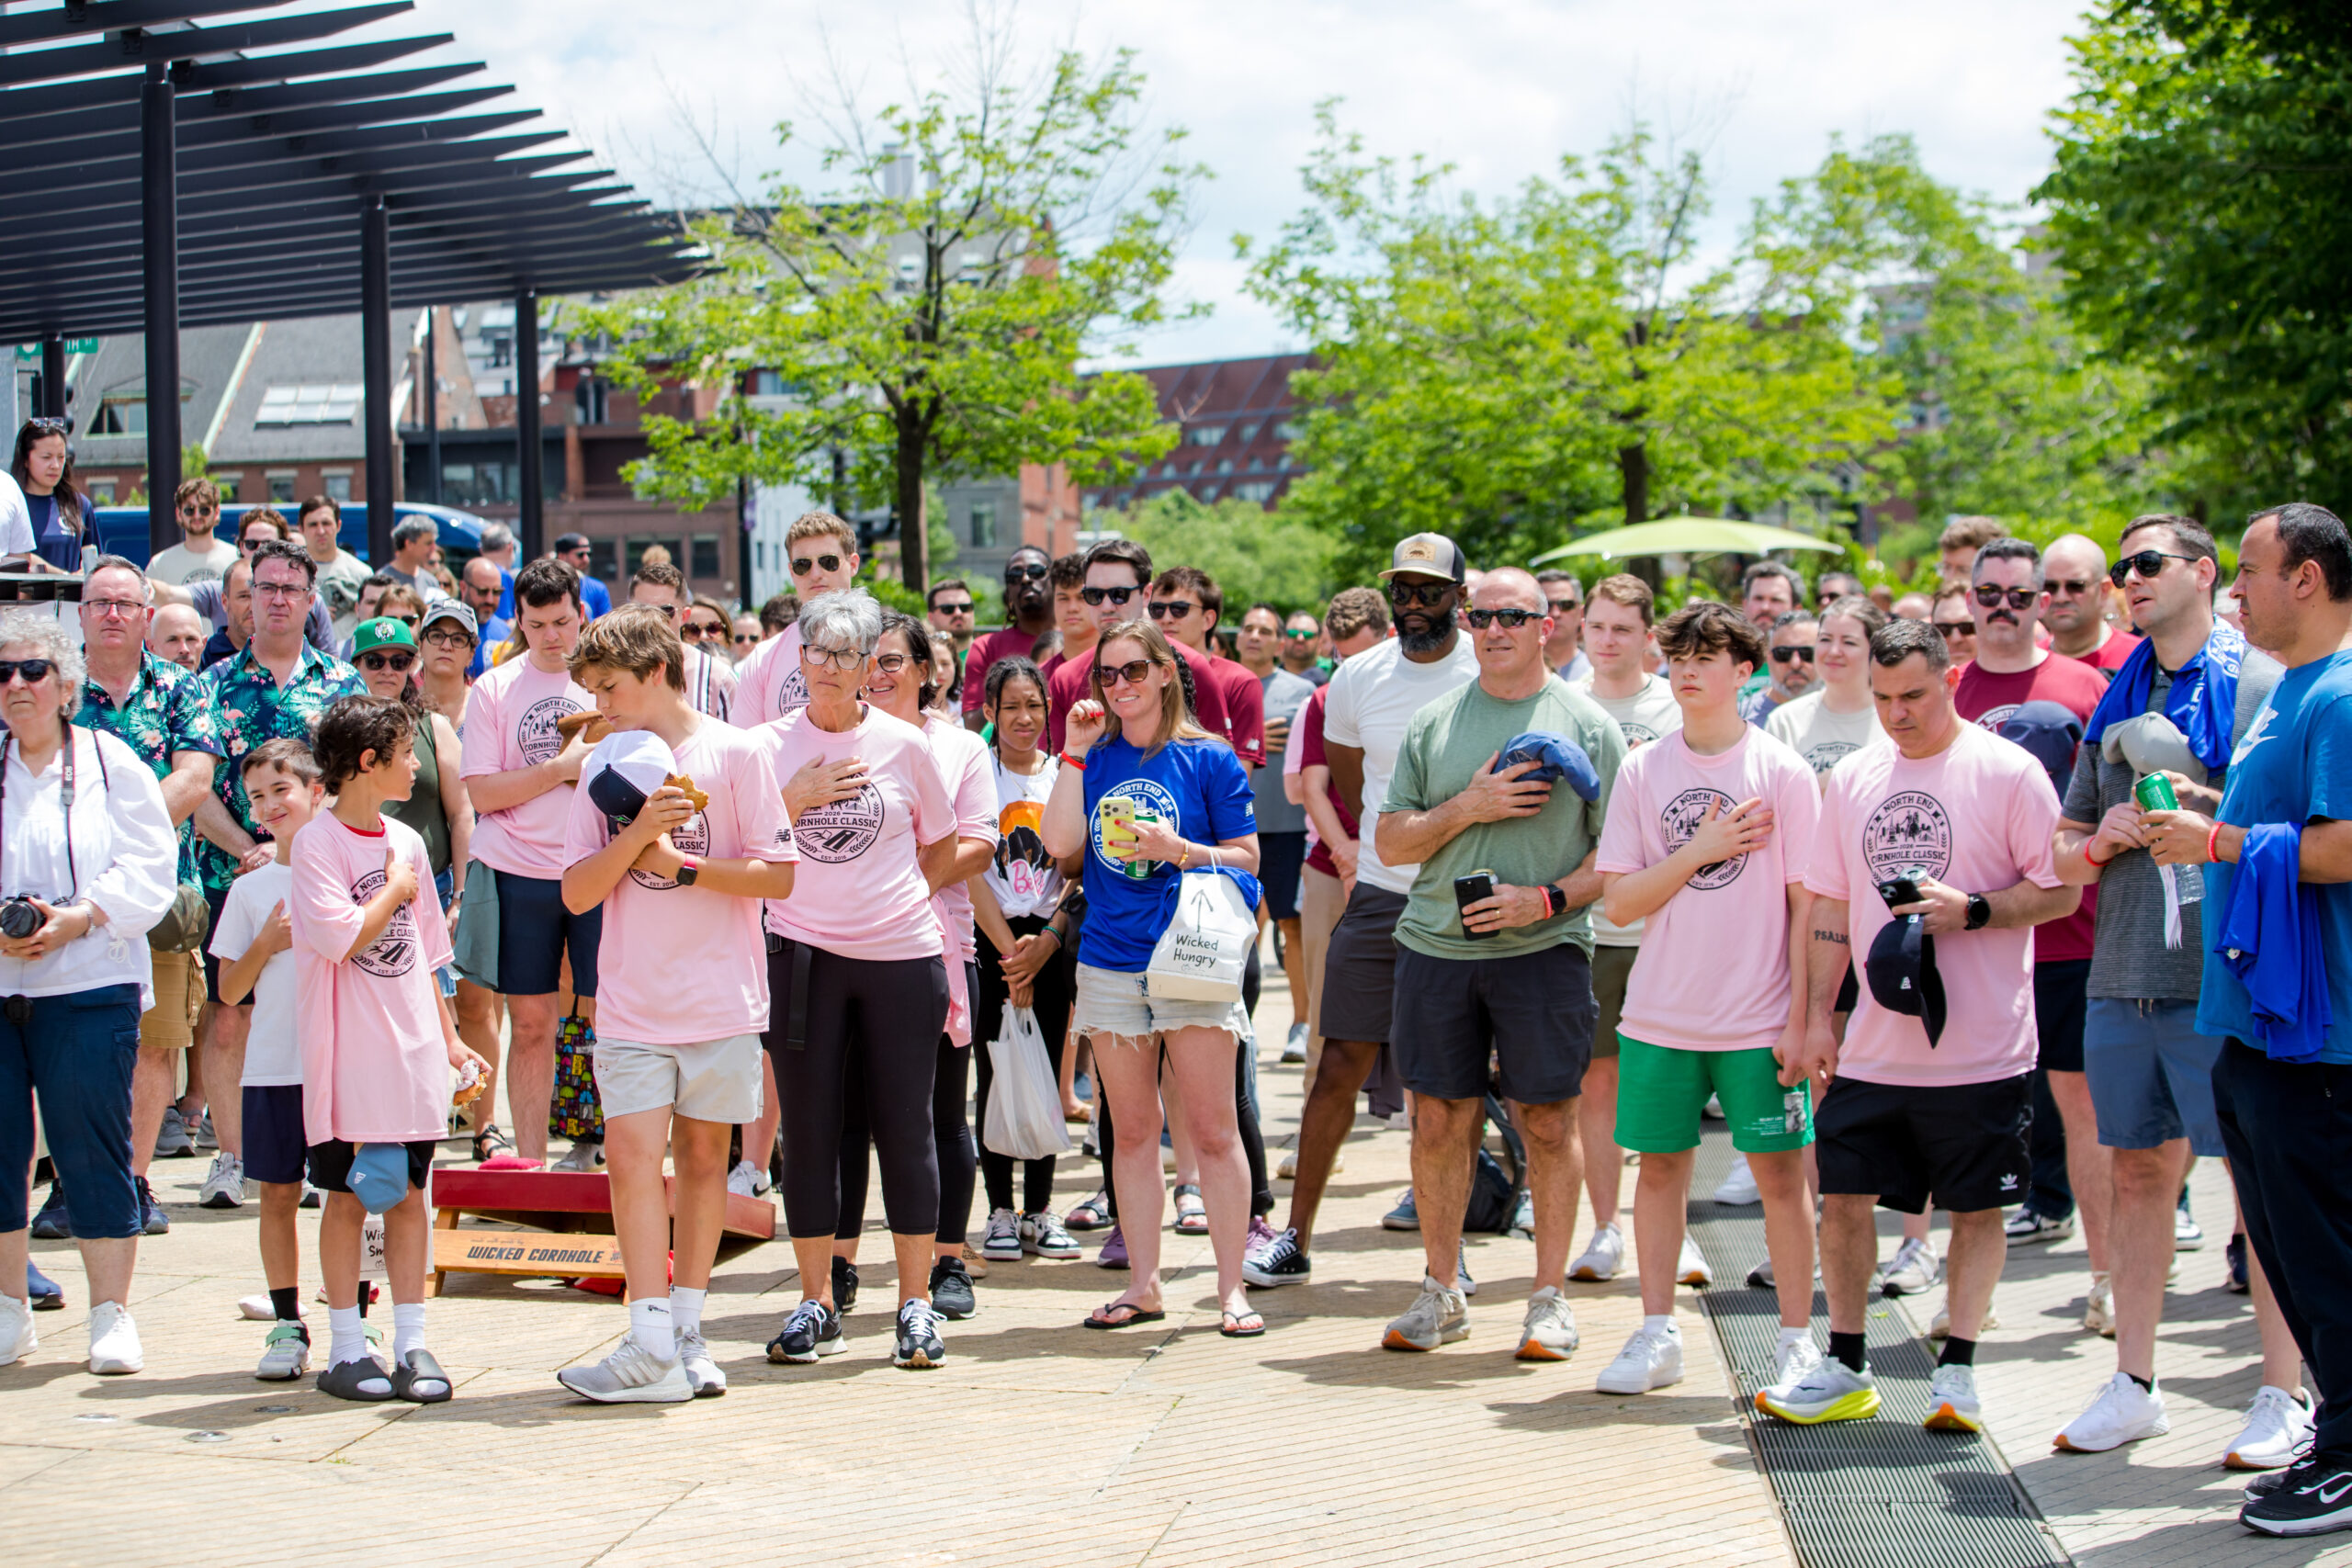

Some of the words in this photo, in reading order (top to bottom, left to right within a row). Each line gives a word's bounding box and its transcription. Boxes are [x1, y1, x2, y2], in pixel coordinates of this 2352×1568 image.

[534, 700, 560, 713] NORTH
[561, 701, 578, 712] END
[525, 740, 561, 752] CORNHOLE
[1112, 783, 1143, 796] NORTH
[1144, 784, 1162, 796] END
[1679, 792, 1711, 807] NORTH
[1883, 795, 1915, 812] NORTH
[1916, 796, 1934, 810] END
[795, 817, 838, 828] ORNHOLE
[840, 817, 878, 829] CLASSIC
[673, 840, 706, 851] LASSIC
[1913, 850, 1947, 862] CLASSIC
[1176, 933, 1219, 952] Wicked
[1173, 948, 1216, 968] Hungry
[467, 1246, 526, 1261] WICKED
[527, 1247, 605, 1264] CORNHOLE
